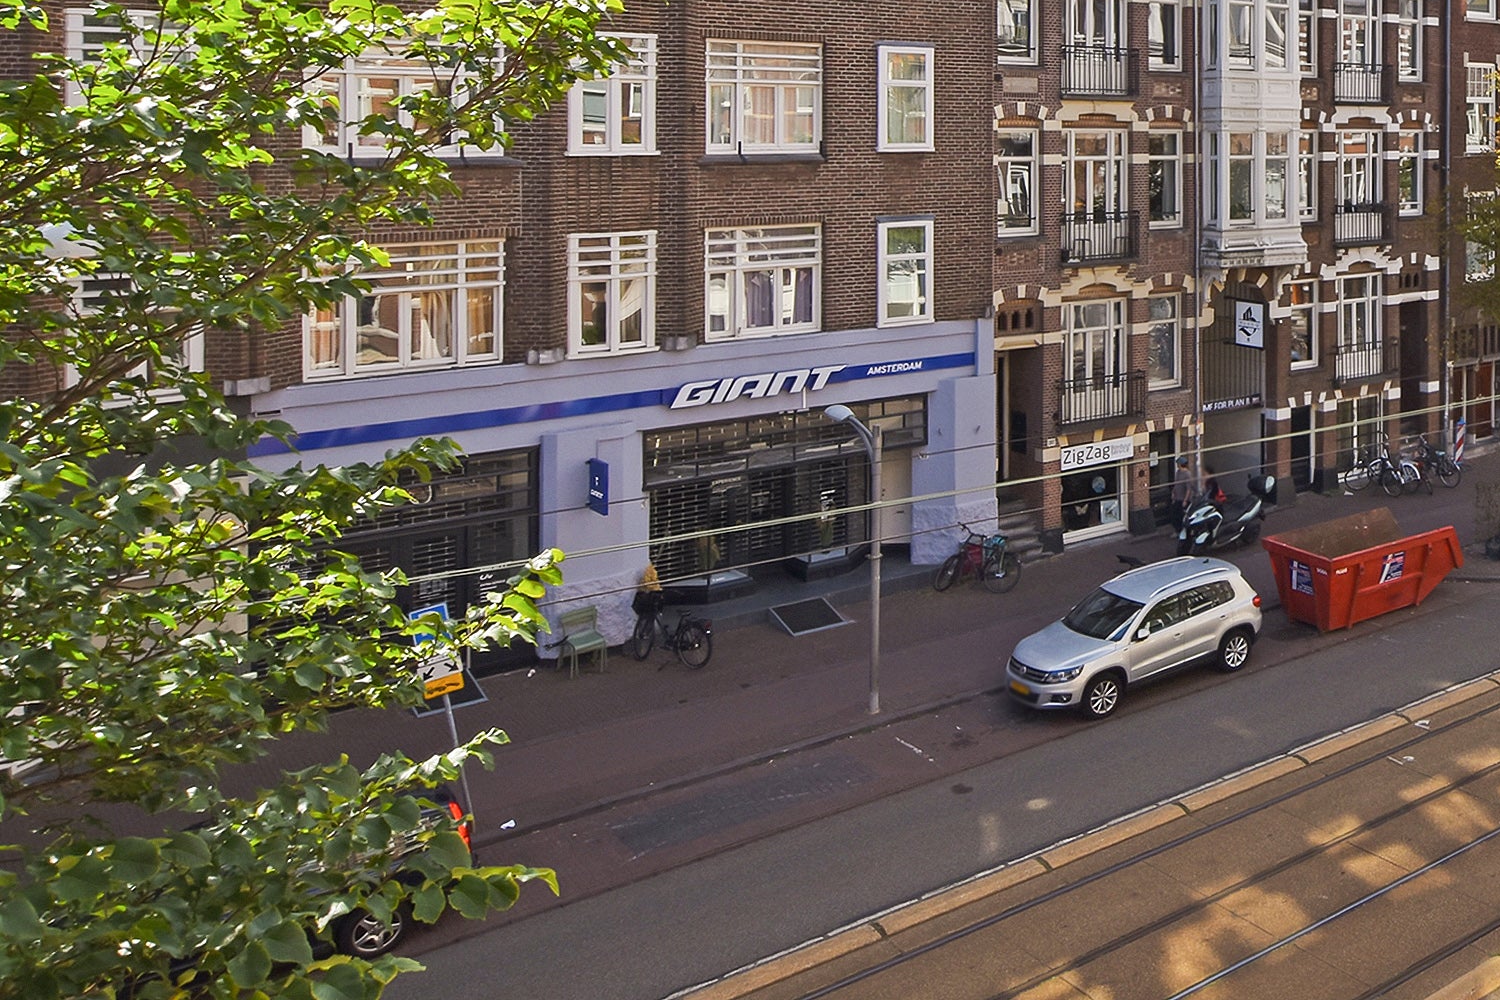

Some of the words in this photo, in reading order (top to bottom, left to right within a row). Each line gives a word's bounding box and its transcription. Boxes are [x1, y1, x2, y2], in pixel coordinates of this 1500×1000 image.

[671, 364, 847, 409] GIANT
[866, 361, 922, 375] AMSTERDAM
[1063, 445, 1110, 465] ZigZag
